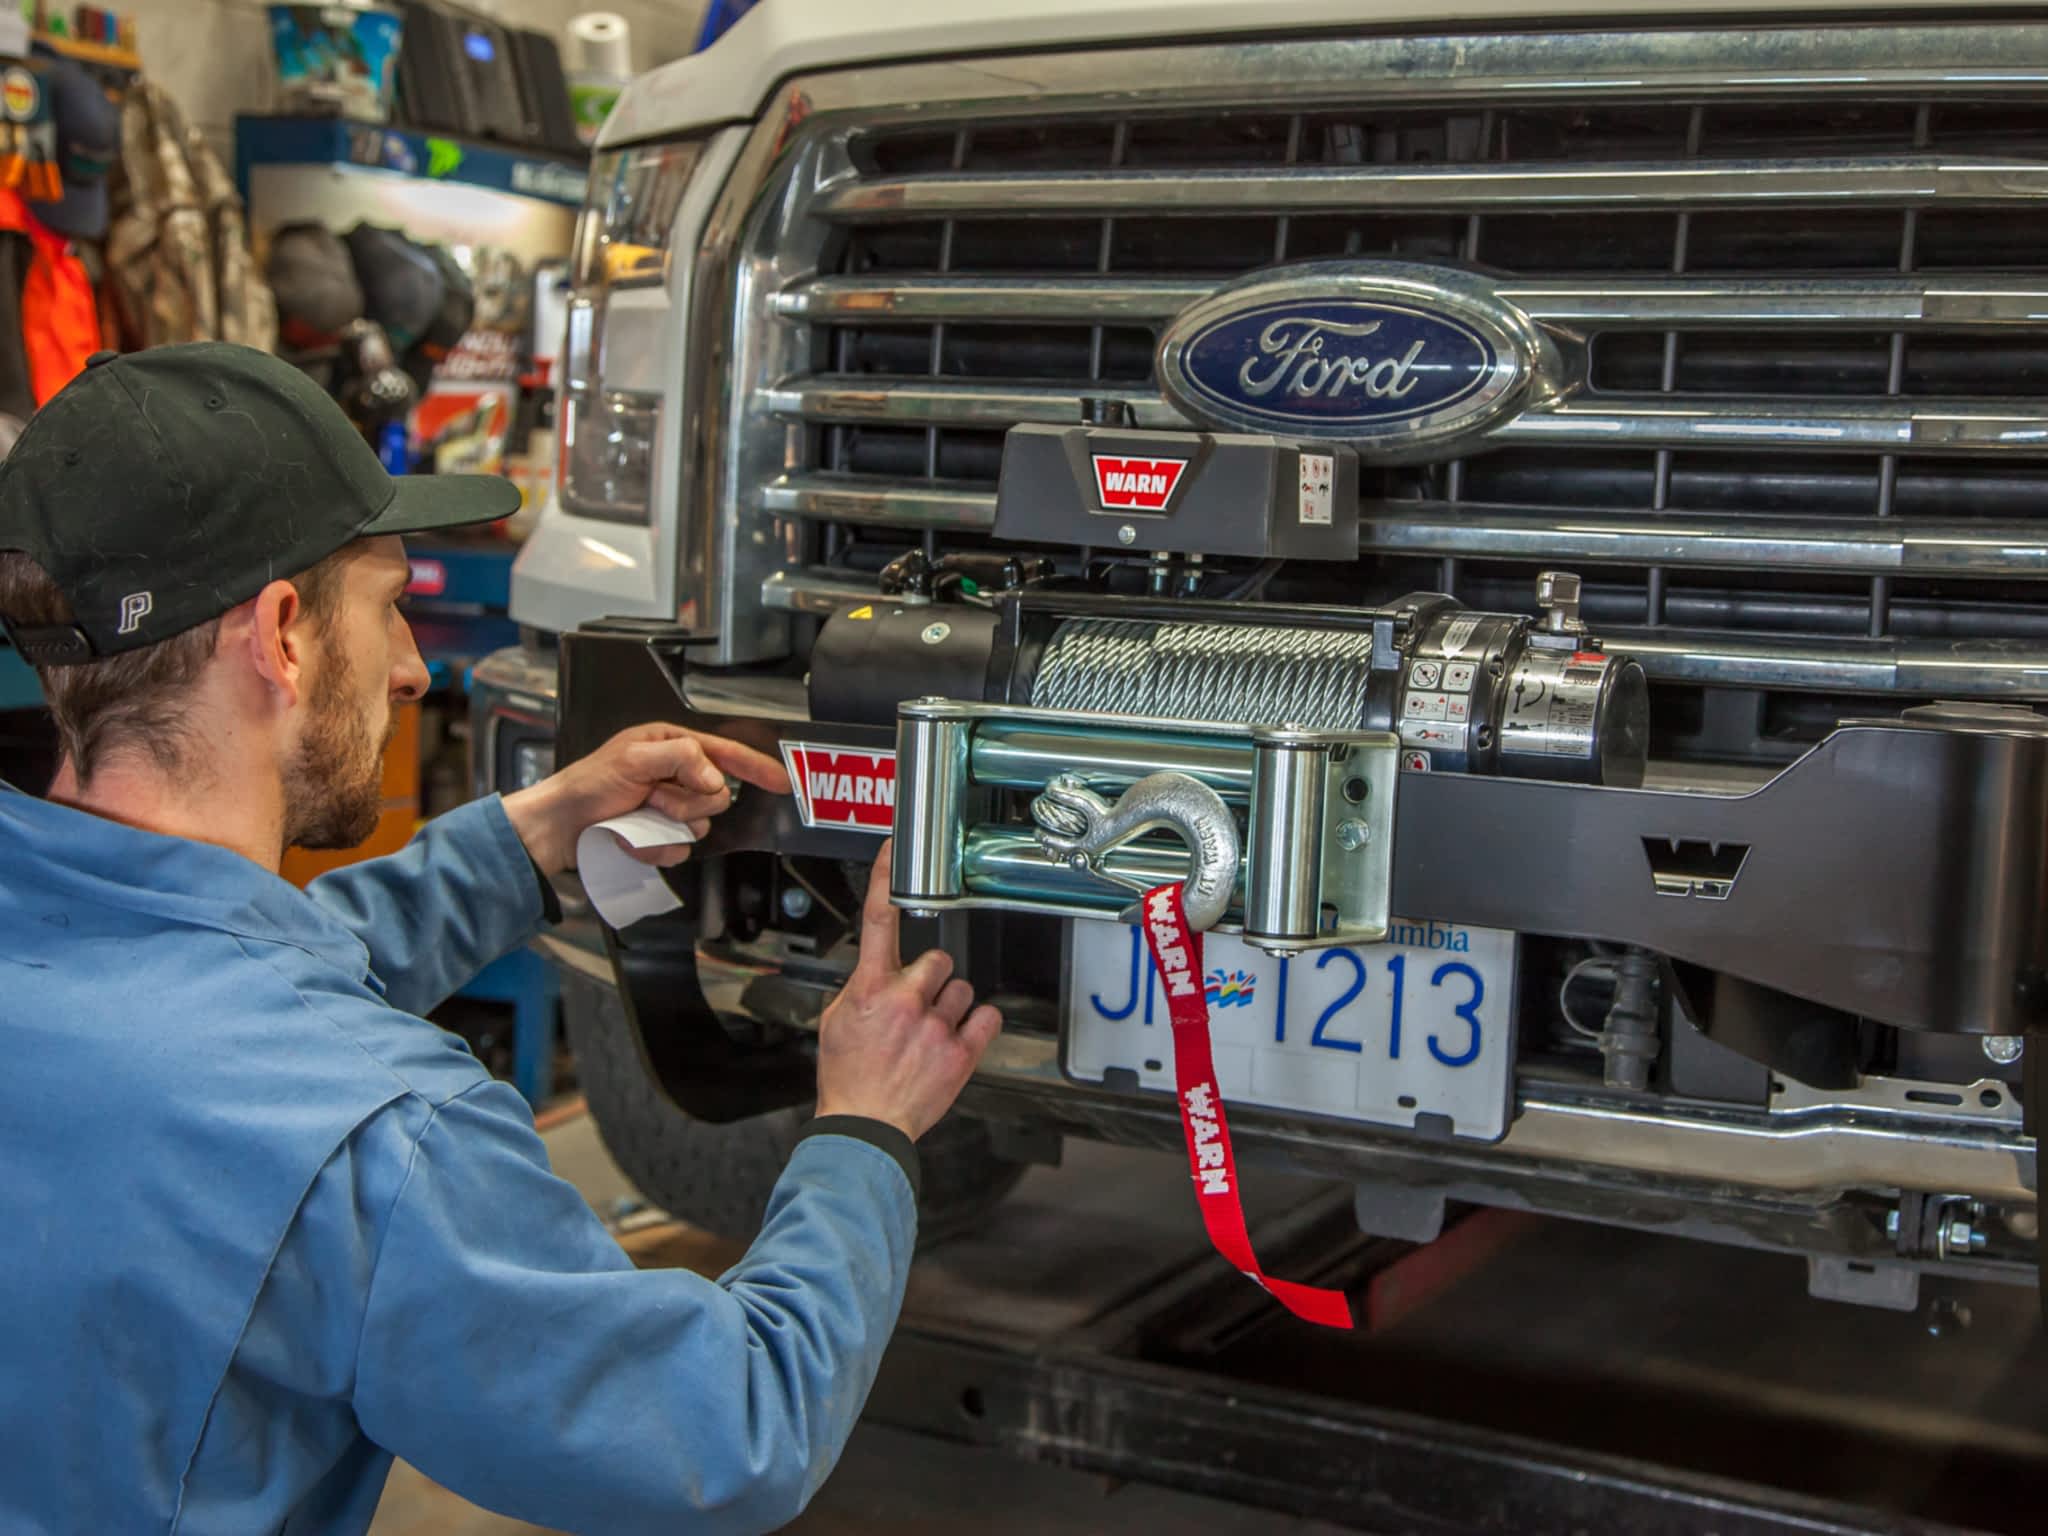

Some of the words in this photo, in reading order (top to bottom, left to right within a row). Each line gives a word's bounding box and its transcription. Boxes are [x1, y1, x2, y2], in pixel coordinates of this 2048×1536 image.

[1239, 318, 1427, 399] Ford
[1105, 471, 1166, 494] WARN
[117, 591, 153, 635] P
[810, 772, 896, 806] WARN
[1148, 886, 1196, 997] WARN
[1275, 947, 1486, 1068] 1213
[1184, 1082, 1230, 1195] WARN
